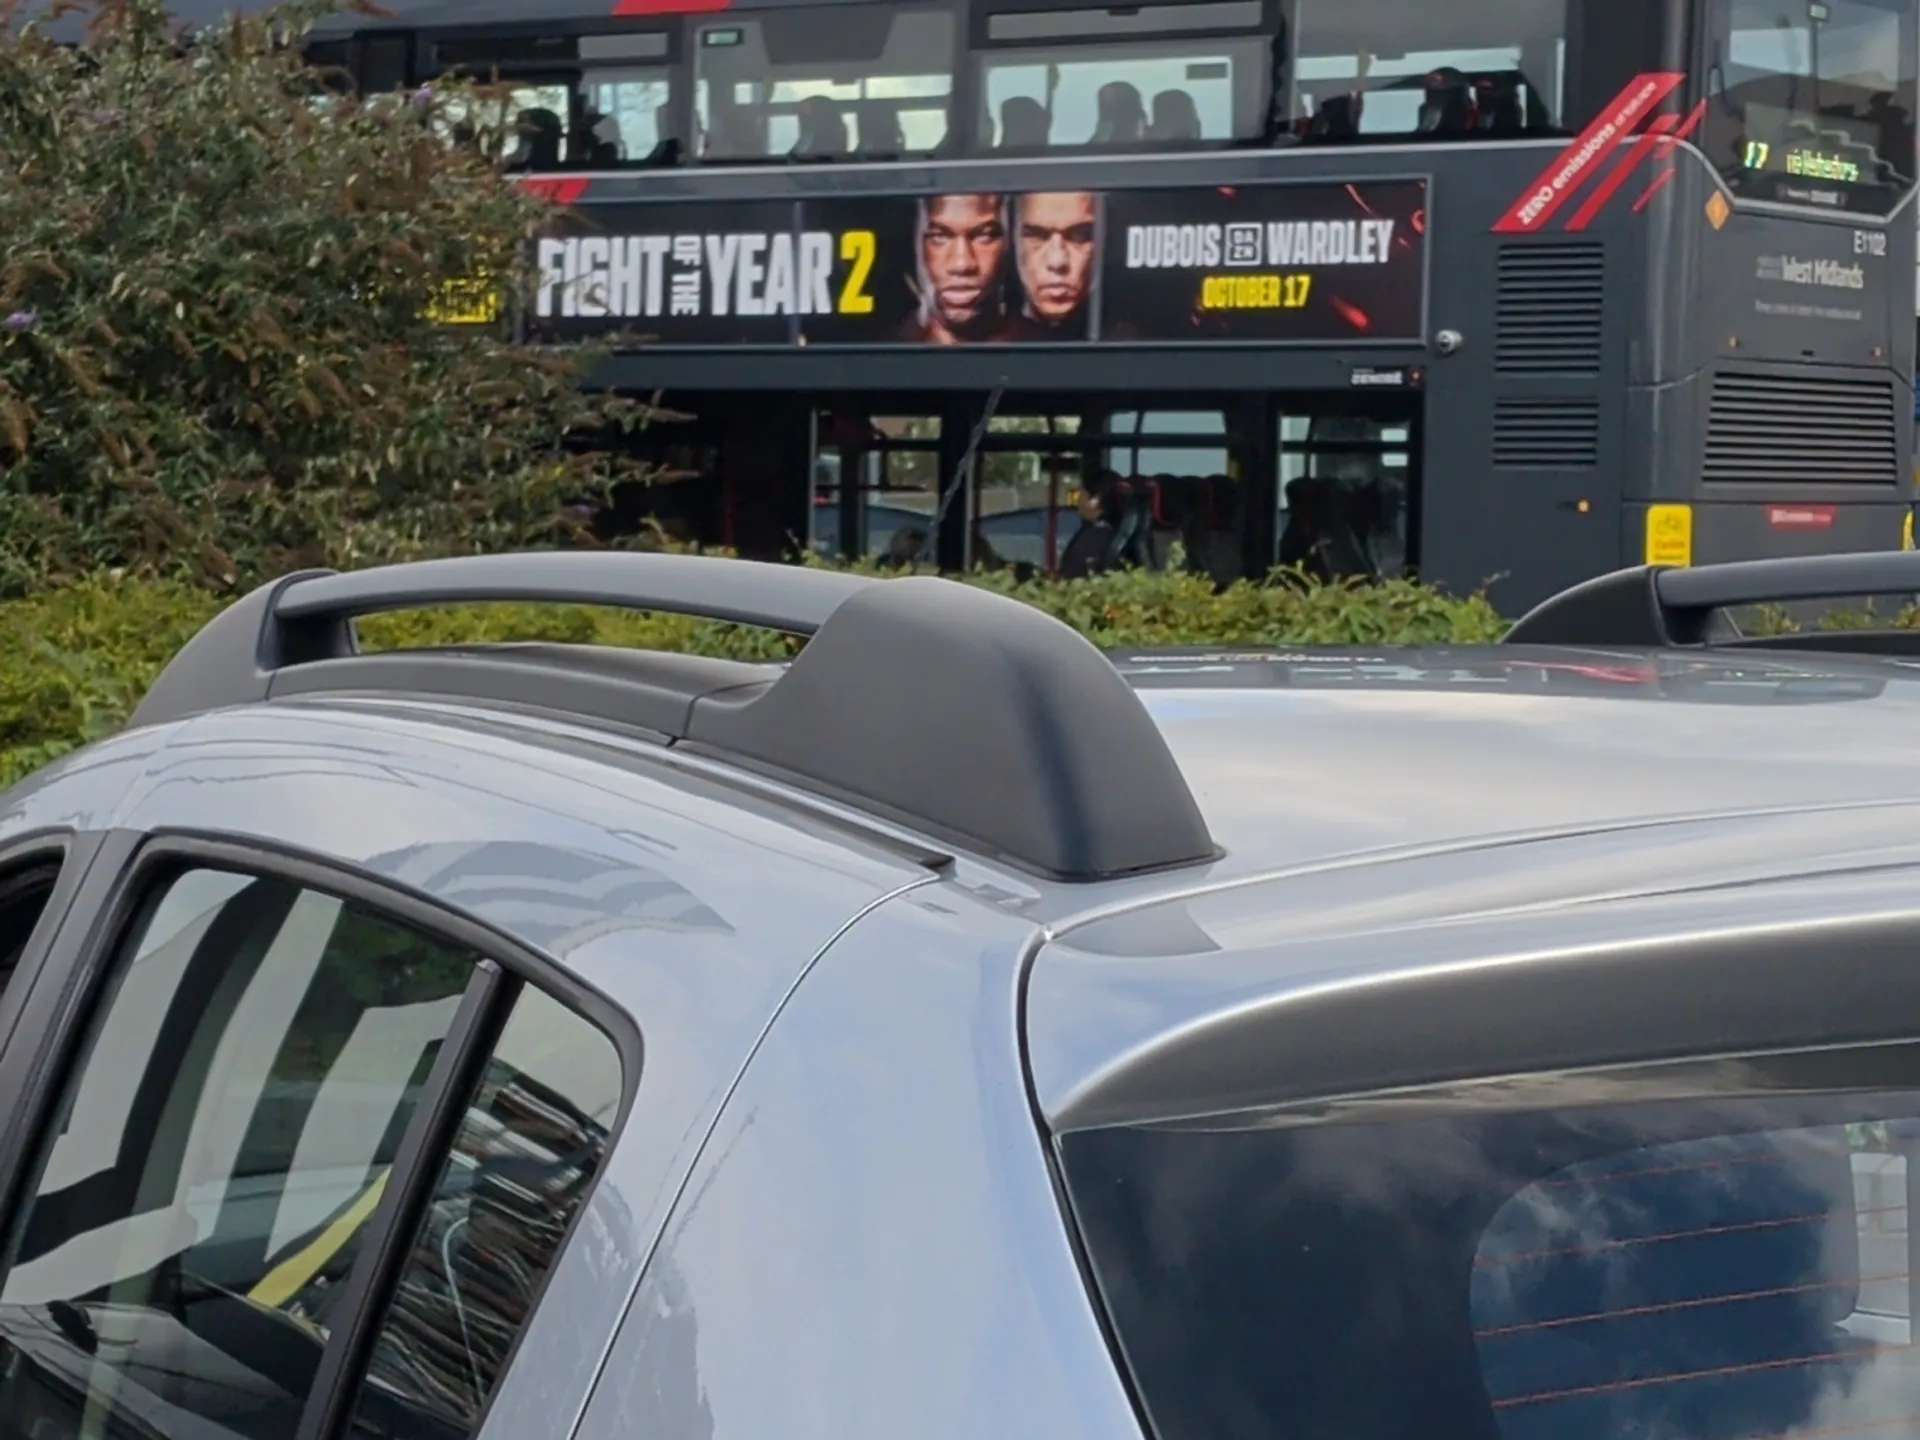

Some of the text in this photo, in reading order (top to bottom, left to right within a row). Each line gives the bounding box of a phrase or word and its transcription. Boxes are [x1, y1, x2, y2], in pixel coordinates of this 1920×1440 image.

[1517, 186, 1554, 225] ZERO
[1552, 123, 1616, 189] emissions
[1744, 141, 1769, 169] 17
[673, 235, 701, 266] OF
[1126, 220, 1394, 268] DUBOIS WARDLEY
[537, 236, 671, 317] FIGHT
[671, 269, 701, 317] THE
[705, 232, 833, 316] YEAR
[838, 231, 875, 314] 2
[1203, 274, 1311, 308] OCTOBER 17
